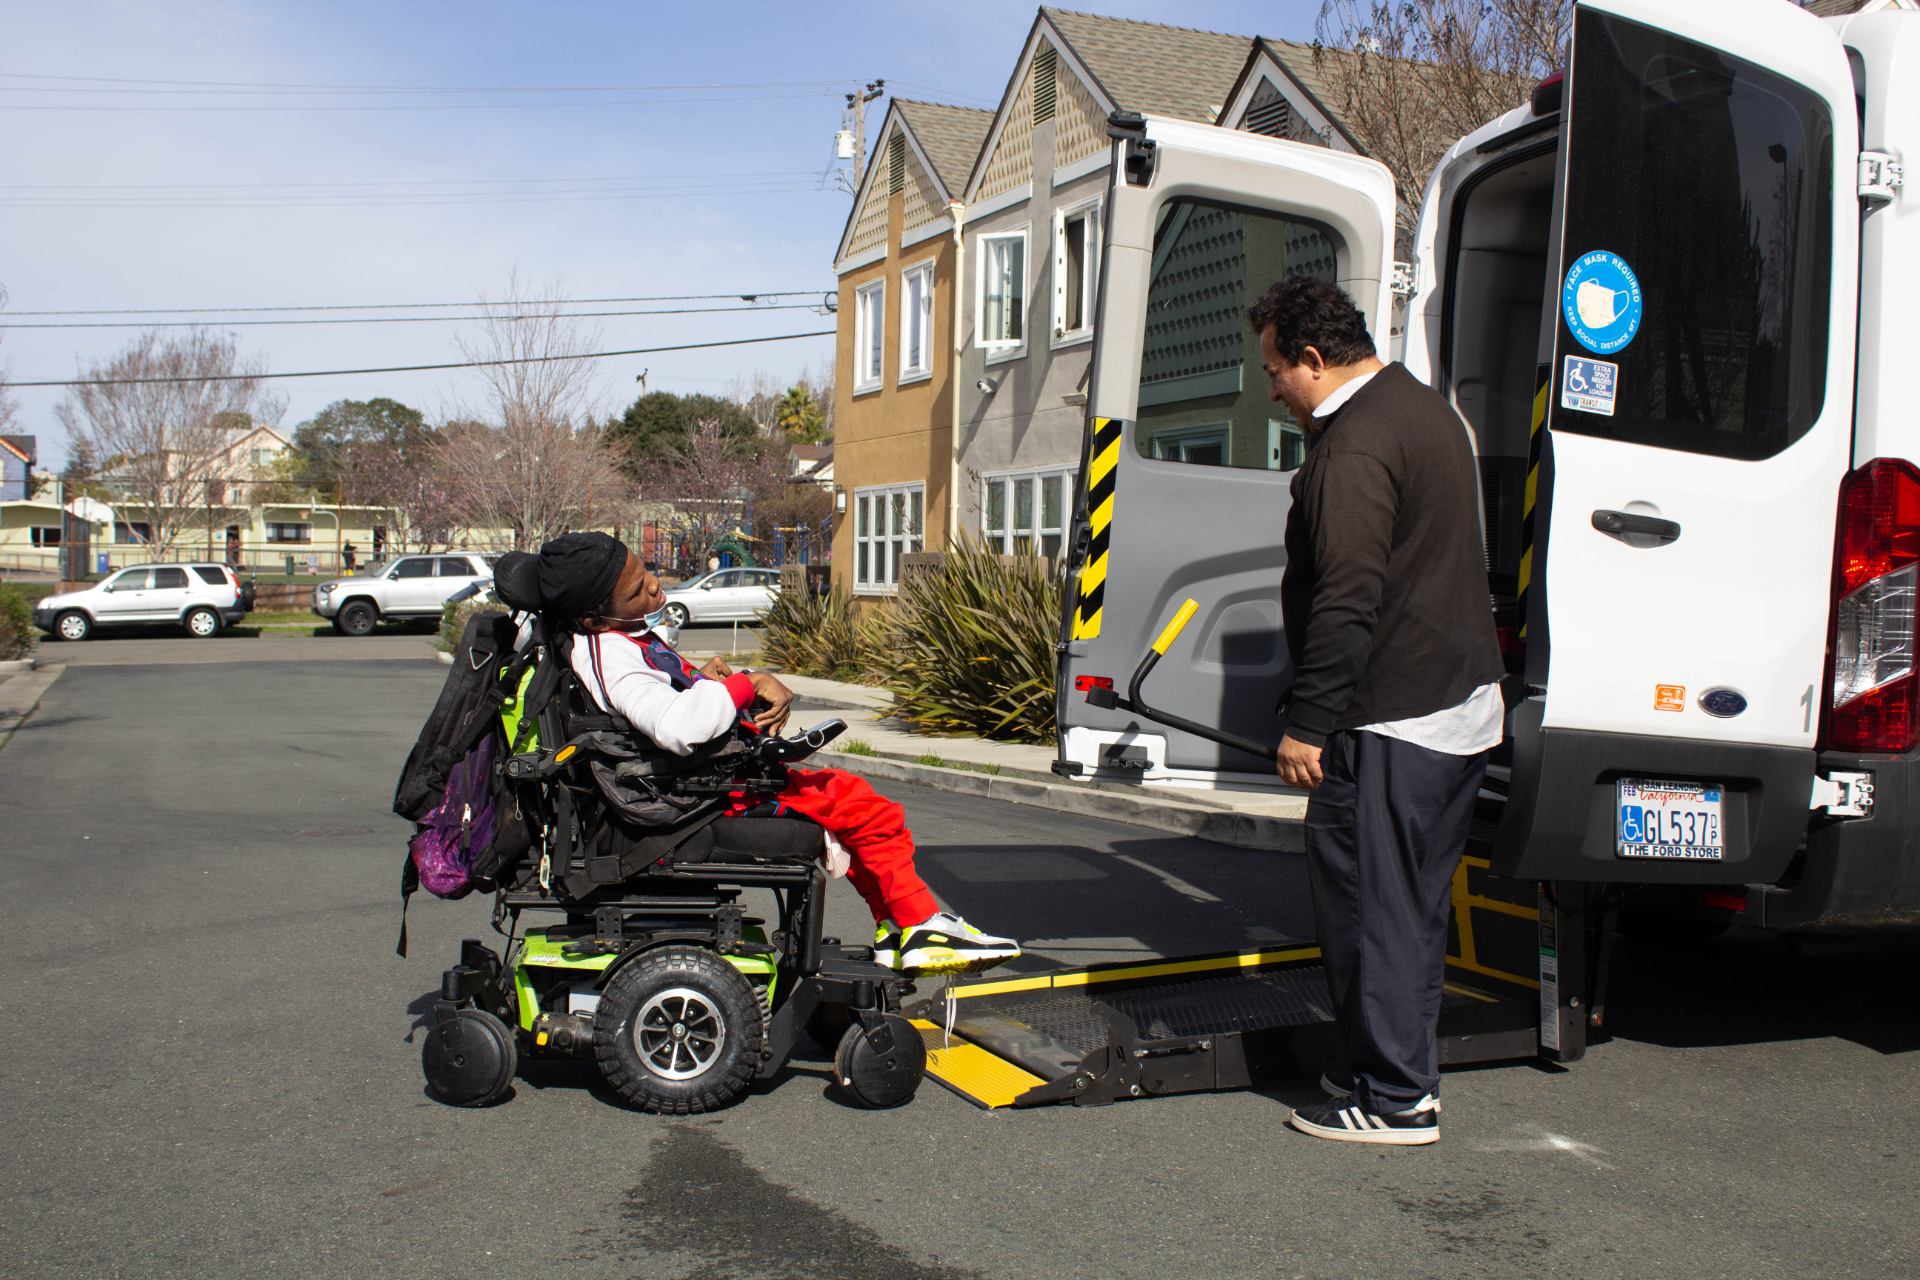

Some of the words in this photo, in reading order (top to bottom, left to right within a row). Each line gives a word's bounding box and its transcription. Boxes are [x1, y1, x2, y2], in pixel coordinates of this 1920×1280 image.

[1567, 265, 1583, 290] FACE
[1584, 254, 1608, 266] MASK
[1611, 258, 1640, 303] REQUIRED
[1567, 306, 1578, 326] KEEP
[1576, 328, 1598, 348] SOCIAL
[1600, 333, 1630, 350] DISTANCE
[1593, 364, 1611, 373] EXTRA
[1591, 377, 1612, 385] NEEDED
[1594, 371, 1610, 379] SPACE
[1588, 388, 1612, 397] LOADING
[1580, 397, 1599, 408] TRANSIT
[1712, 694, 1739, 711] Ford
[1799, 684, 1814, 733] 1
[1623, 786, 1636, 797] FEB
[1644, 780, 1662, 790] SAN
[1664, 781, 1699, 792] LEANDRO
[1644, 809, 1708, 847] GL537
[1627, 844, 1648, 856] THE
[1653, 845, 1682, 857] FORD
[1685, 846, 1720, 858] STORE
